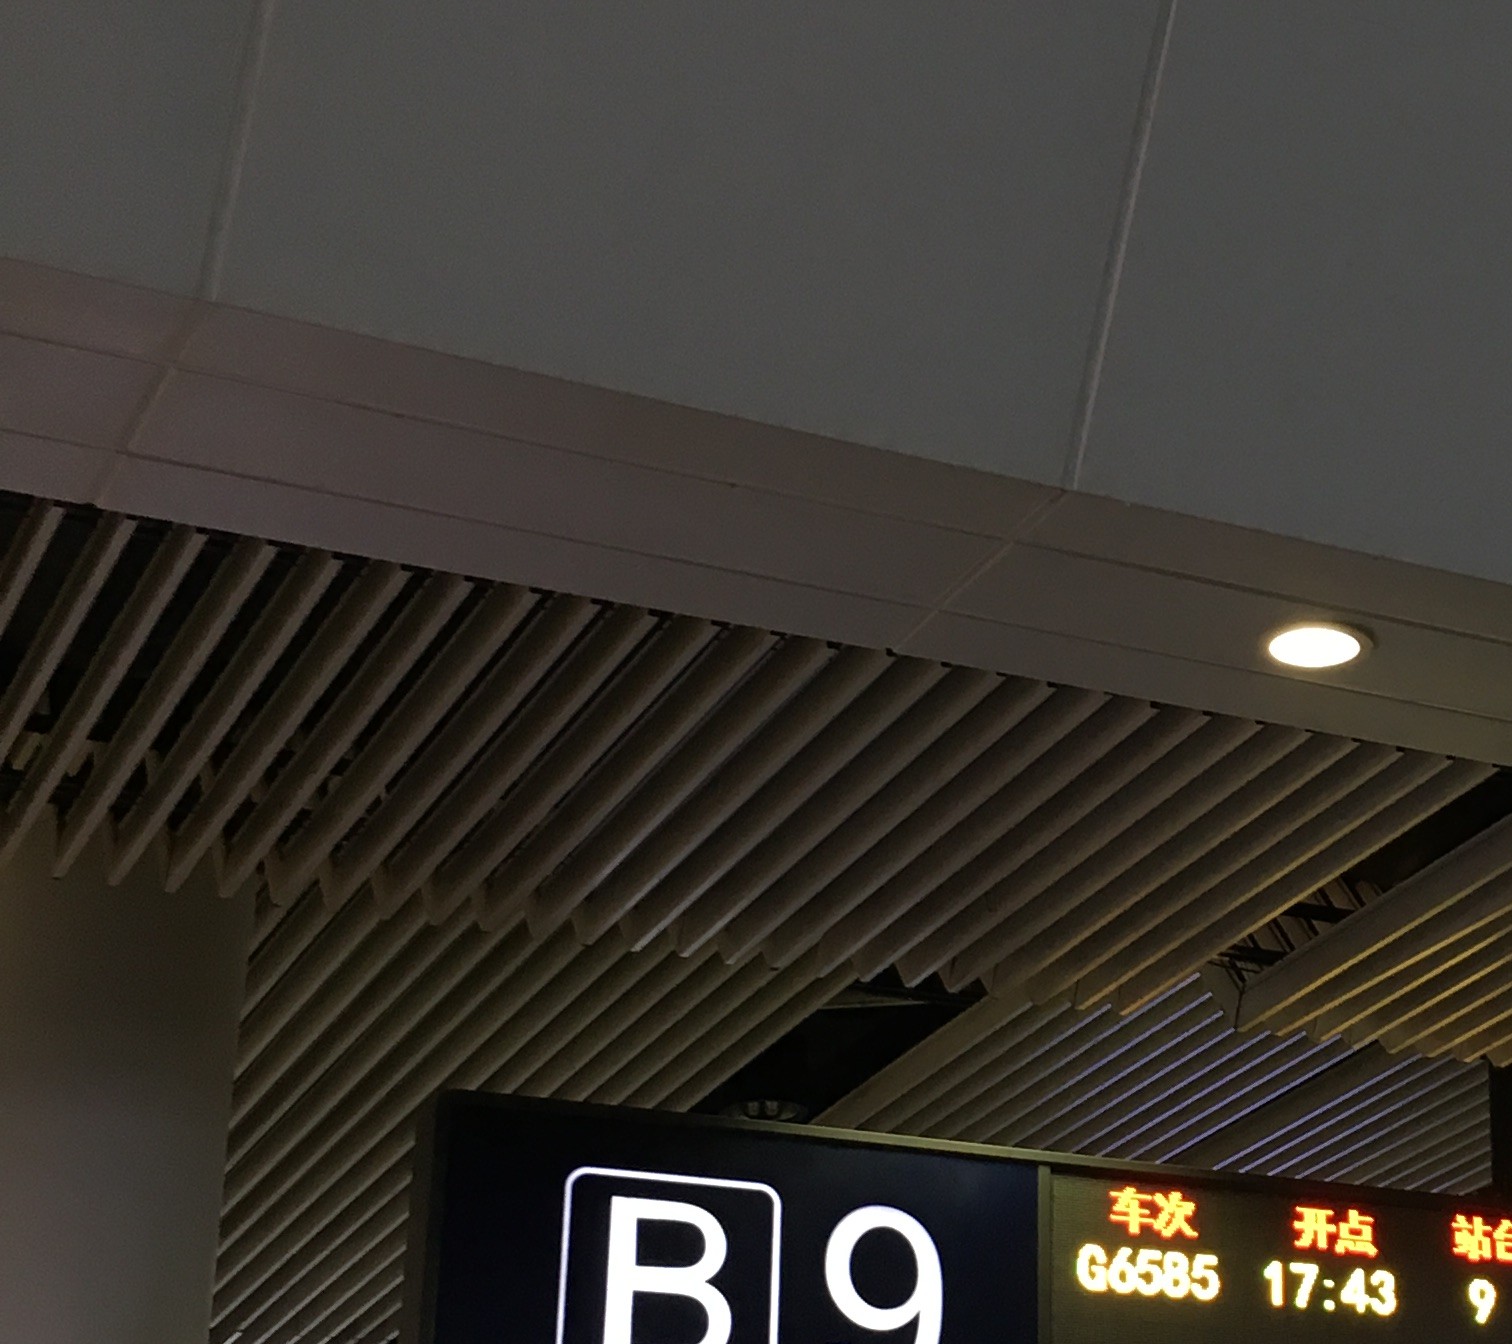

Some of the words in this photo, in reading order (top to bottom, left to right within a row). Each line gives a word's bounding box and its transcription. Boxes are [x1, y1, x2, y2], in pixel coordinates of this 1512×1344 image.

[1109, 1186, 1198, 1241] 车次
[1291, 1205, 1379, 1257] 开点
[1076, 1242, 1222, 1302] G6585
[1263, 1260, 1399, 1317] 17:43
[1467, 1278, 1498, 1325] 9
